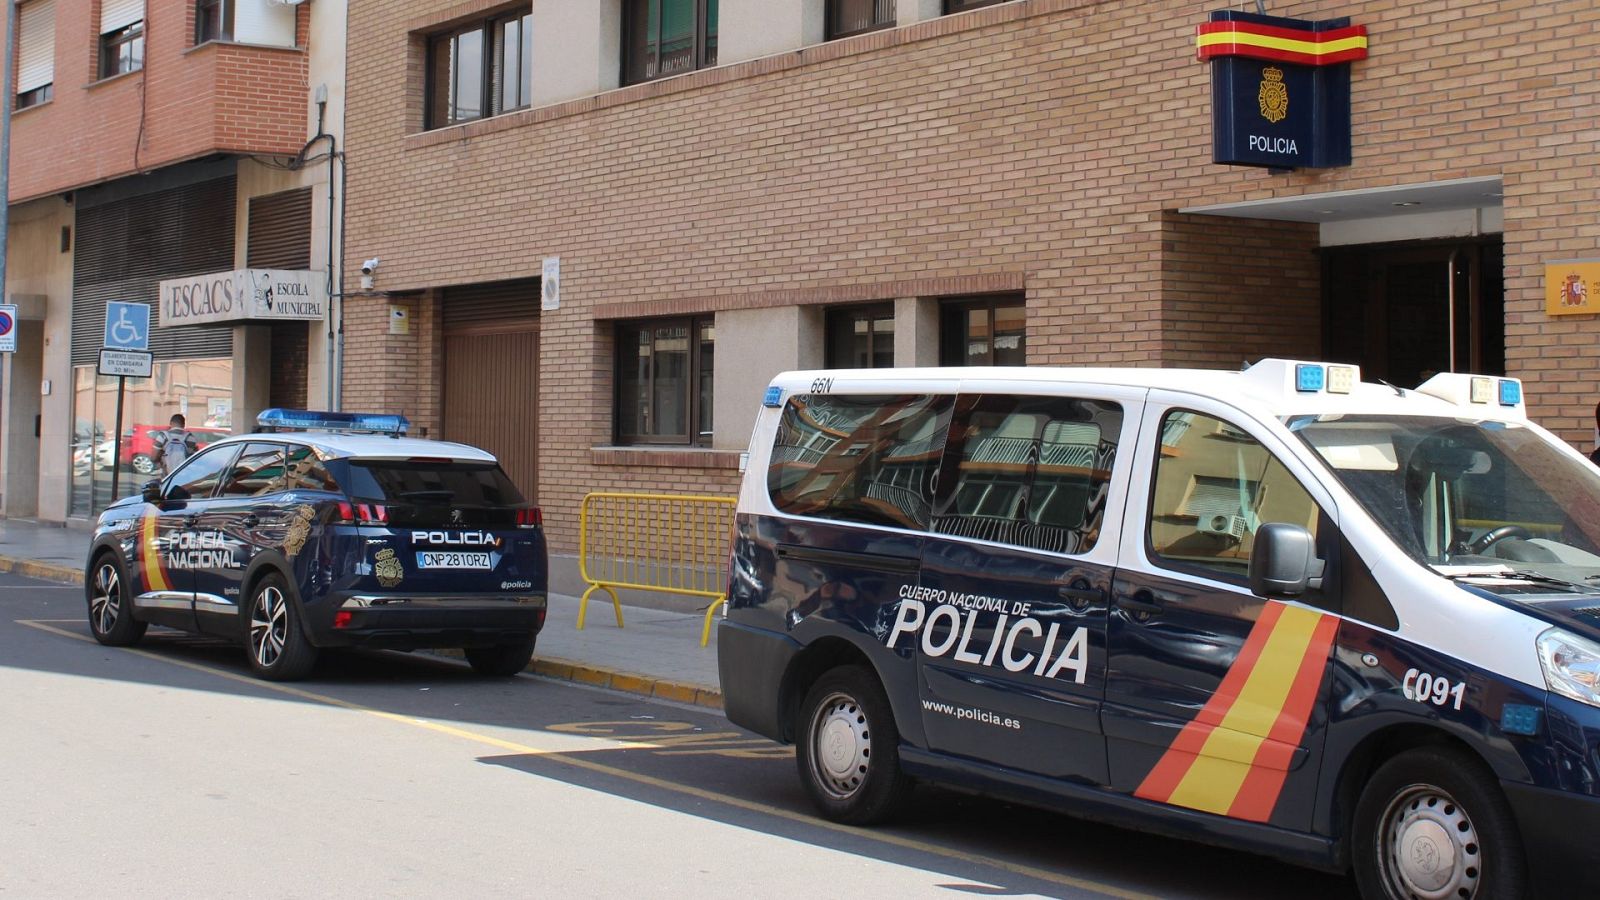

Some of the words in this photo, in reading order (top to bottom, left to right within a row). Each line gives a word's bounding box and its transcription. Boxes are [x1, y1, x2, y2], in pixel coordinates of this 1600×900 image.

[1249, 135, 1298, 155] POLICIA
[172, 278, 233, 318] ESCACS
[277, 282, 309, 296] ESCOLA
[277, 302, 322, 315] MUNICIPAL
[810, 377, 835, 394] 66N
[411, 530, 496, 545] POLICÍA
[168, 550, 241, 568] NACIONAL
[500, 580, 532, 590] @policia
[899, 584, 947, 603] CUERPO
[948, 591, 1009, 615] NACIONAL
[1011, 601, 1031, 617] DE
[886, 598, 1088, 685] POLICIA
[922, 699, 1021, 729] www.policia.es
